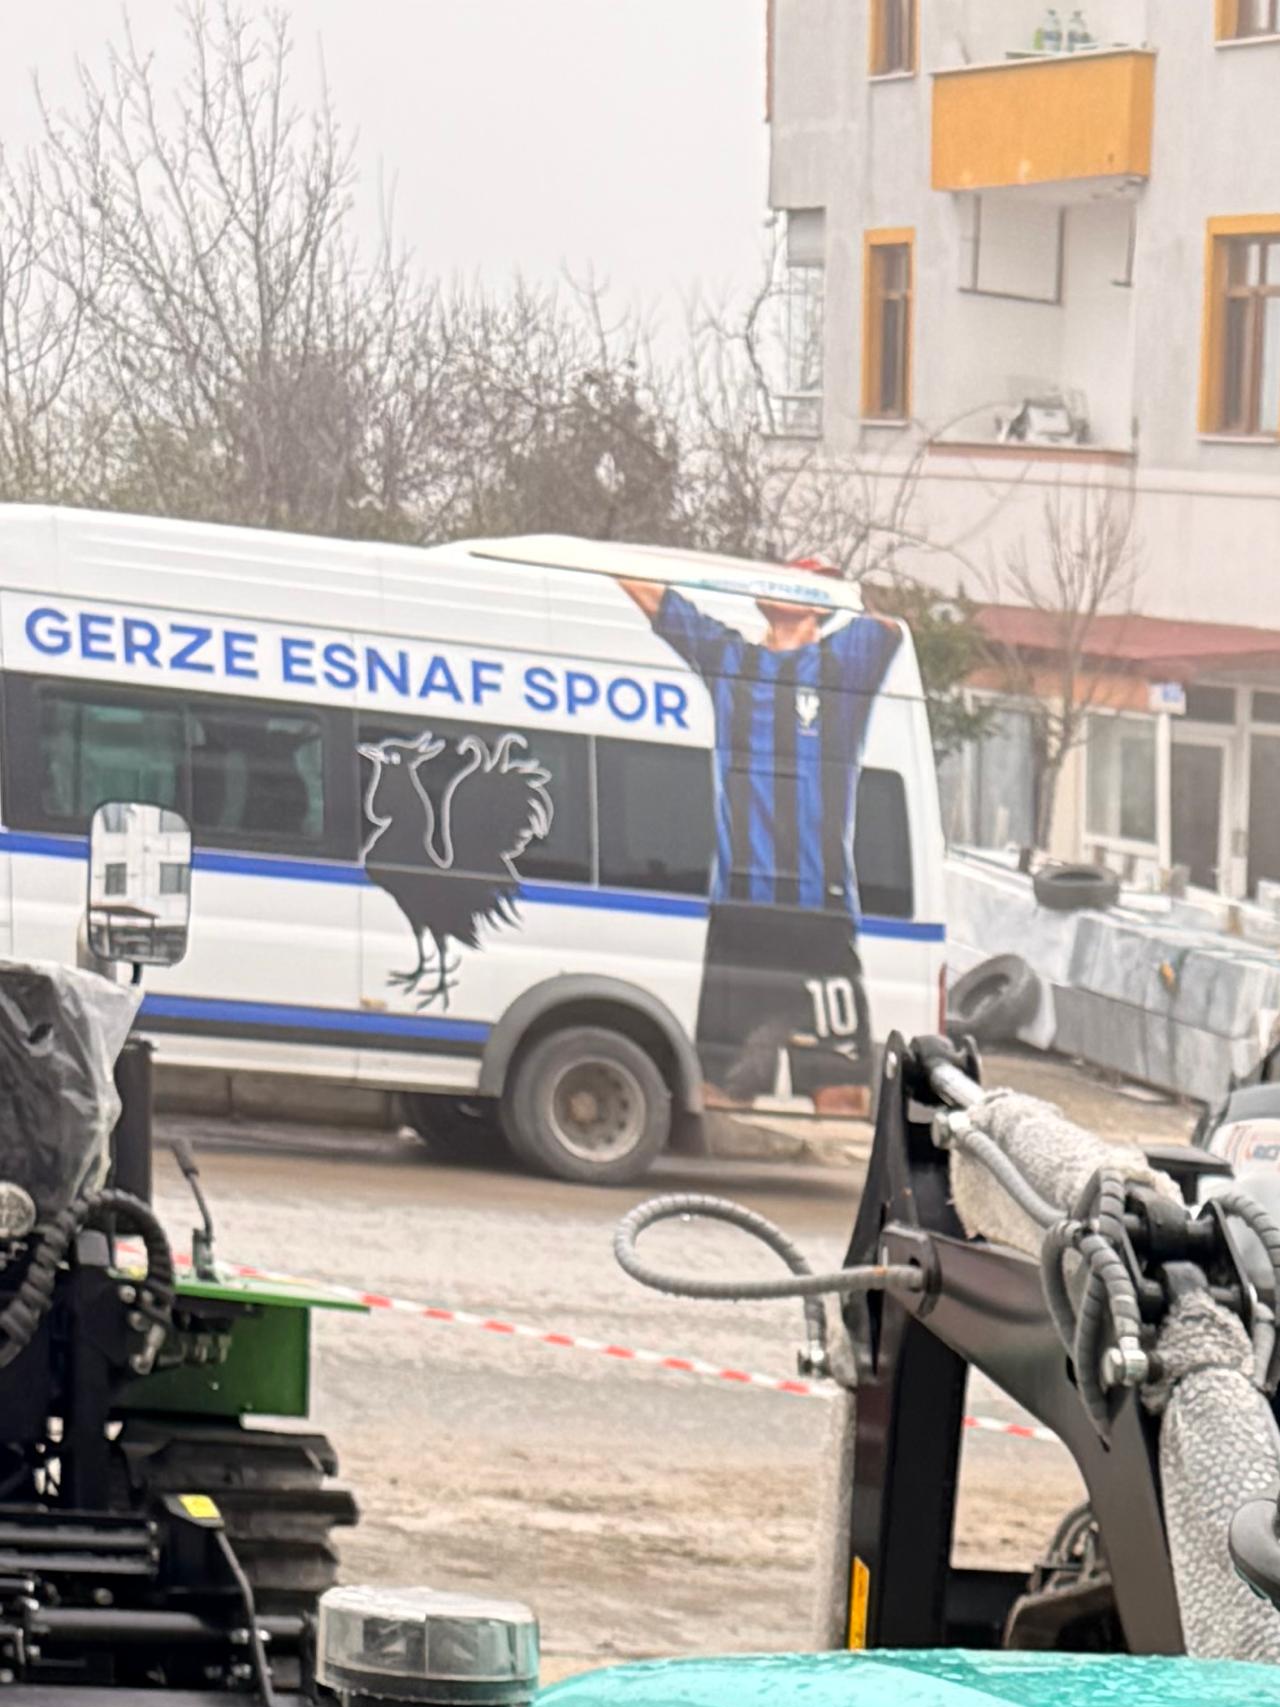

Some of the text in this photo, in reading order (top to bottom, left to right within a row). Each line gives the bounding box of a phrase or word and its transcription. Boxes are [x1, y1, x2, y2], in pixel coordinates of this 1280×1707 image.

[25, 606, 690, 731] GERZE ESNAF SPOR
[804, 976, 859, 1038] 10
